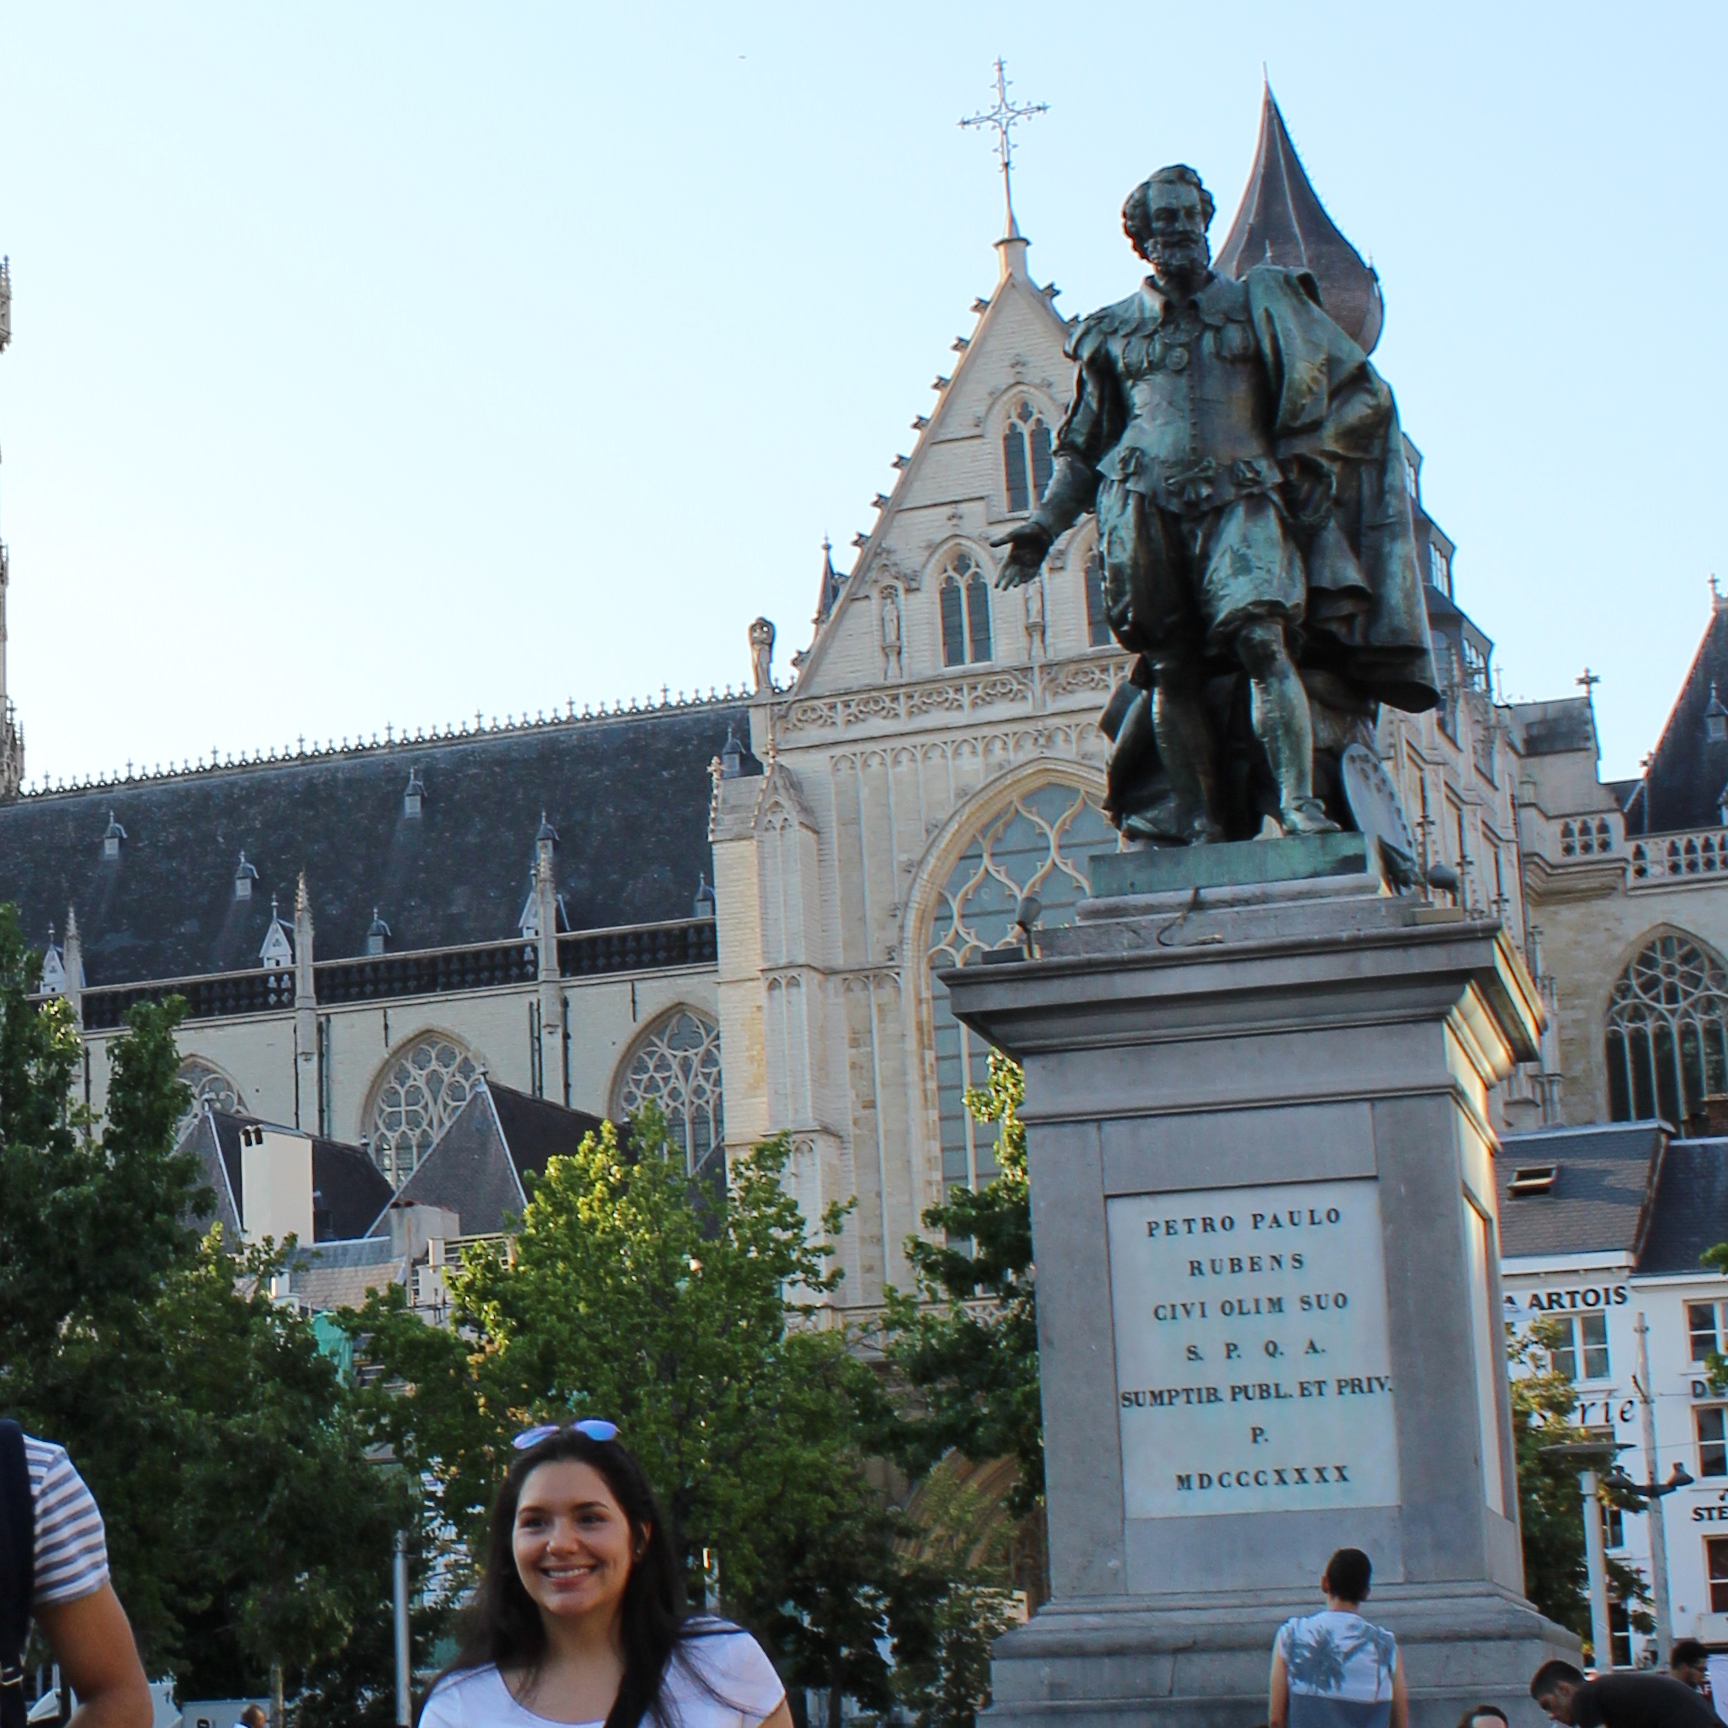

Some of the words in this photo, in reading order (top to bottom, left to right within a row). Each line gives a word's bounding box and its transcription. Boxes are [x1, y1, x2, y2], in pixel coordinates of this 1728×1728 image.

[1146, 1214, 1236, 1238] PETRO
[1251, 1207, 1341, 1230] PAULO
[1188, 1252, 1305, 1277] RUBENS
[1153, 1301, 1208, 1322] CIVI
[1219, 1296, 1285, 1317] OLIM
[1299, 1292, 1348, 1312] SUO
[1528, 1285, 1629, 1311] ARTOIS
[1186, 1344, 1204, 1362] S.
[1224, 1342, 1242, 1360] P.
[1264, 1339, 1285, 1358] Q.
[1304, 1338, 1326, 1355] A.
[1120, 1387, 1224, 1408] SUMPTIB.
[1229, 1381, 1294, 1403] PUBL.
[1298, 1379, 1327, 1398] ET
[1335, 1374, 1394, 1396] PRIV.
[1249, 1426, 1269, 1444] P.
[1176, 1465, 1350, 1491] MDCCCXXXX
